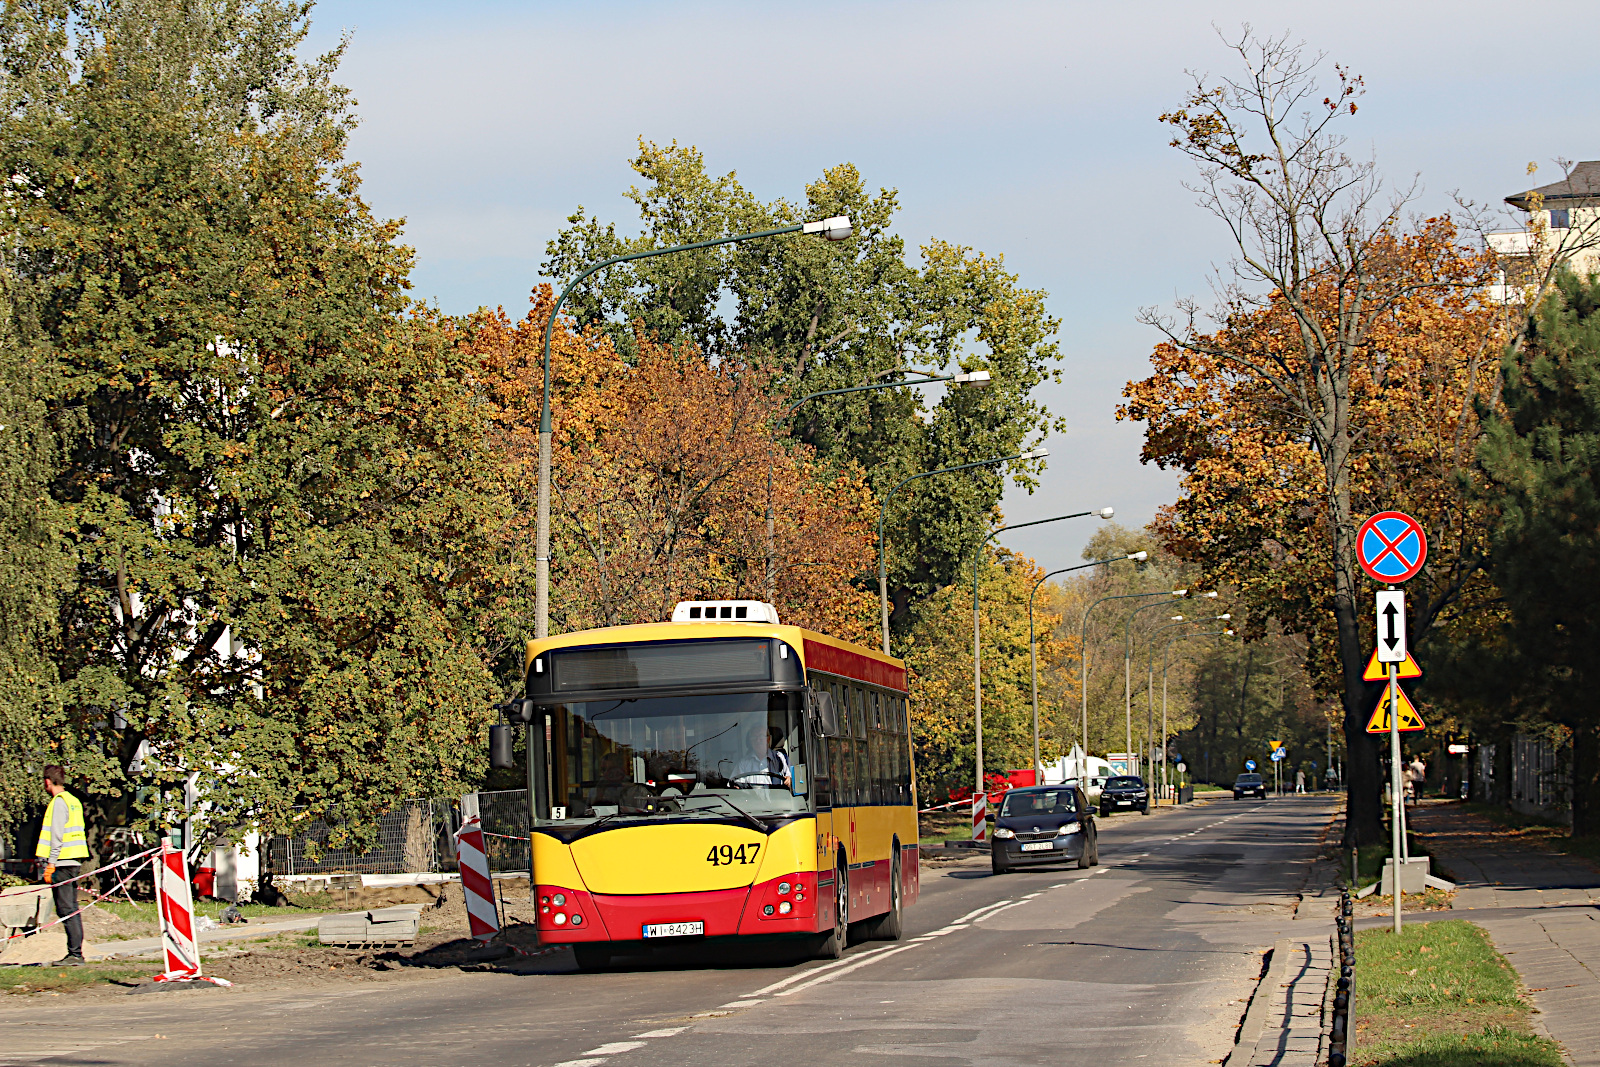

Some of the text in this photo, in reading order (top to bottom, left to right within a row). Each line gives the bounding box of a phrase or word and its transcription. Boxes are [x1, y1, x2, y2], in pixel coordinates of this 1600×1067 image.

[556, 807, 561, 819] 5
[706, 842, 761, 866] 4947
[649, 925, 663, 936] WI
[668, 923, 702, 935] 8423H
